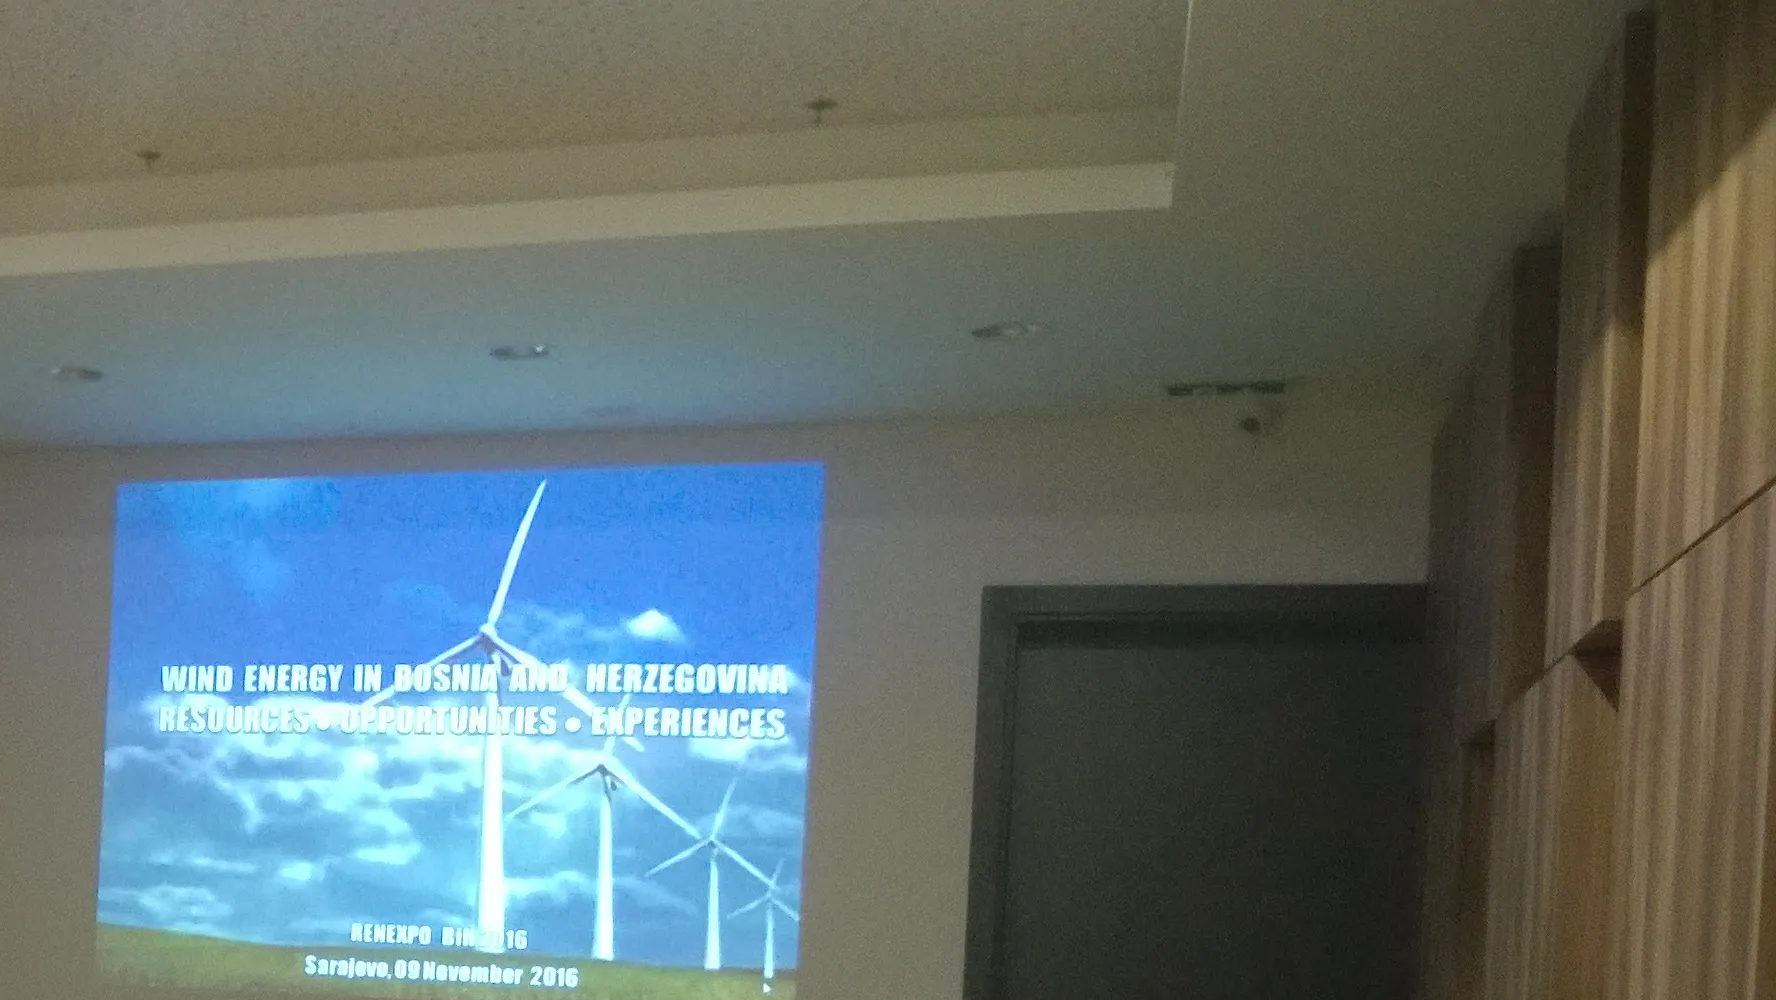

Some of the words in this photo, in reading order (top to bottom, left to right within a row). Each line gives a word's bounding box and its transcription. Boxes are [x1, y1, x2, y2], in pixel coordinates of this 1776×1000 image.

[161, 665, 233, 692] WIND
[243, 664, 343, 692] ENERGY
[353, 664, 382, 692] IN
[393, 664, 498, 692] BOSNIA
[508, 663, 569, 692] AND
[586, 663, 789, 694] HERZEGOVINA
[159, 705, 310, 733] RESOURCES
[339, 705, 557, 735] OPPORTUNITIES
[590, 706, 786, 738] EXPERIENCES
[350, 922, 432, 946] RENEXPO
[304, 955, 392, 980] Sarajevo,
[394, 959, 421, 980] 09
[422, 961, 524, 985] November
[530, 965, 579, 988] 2016
